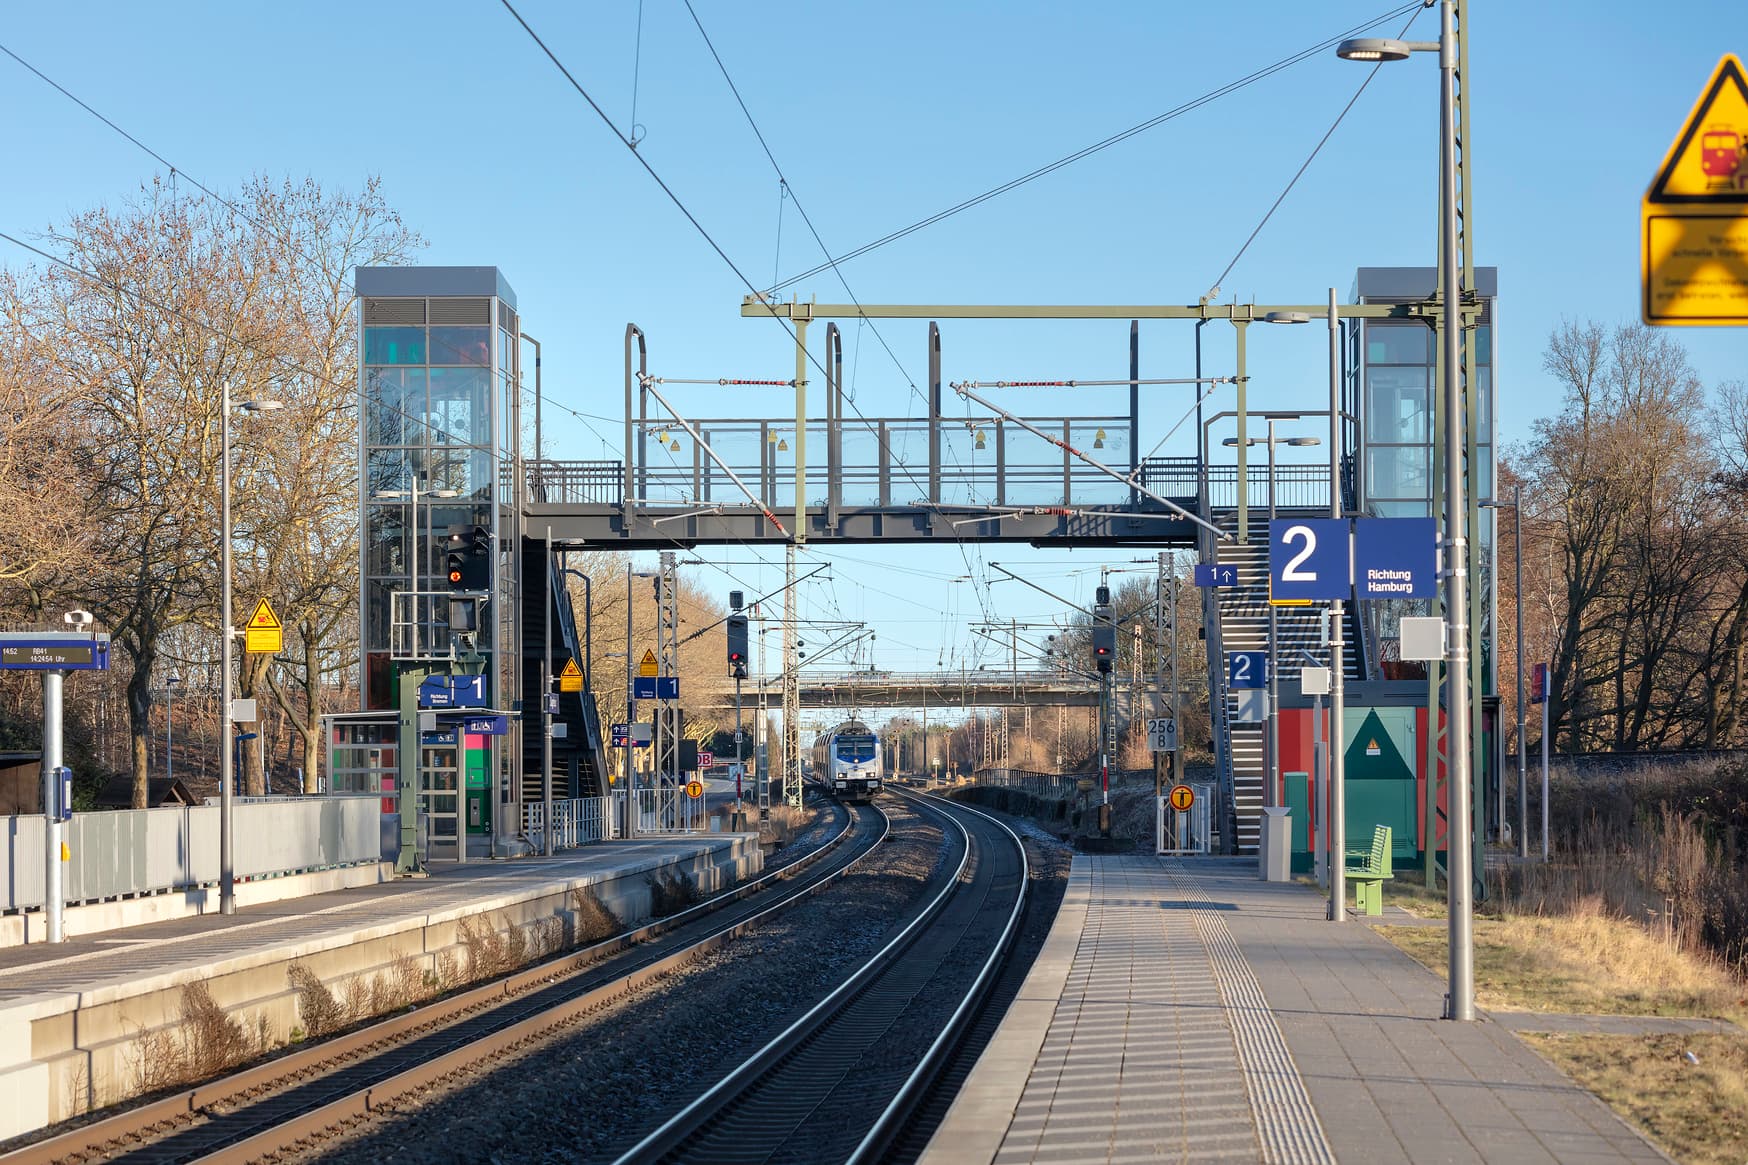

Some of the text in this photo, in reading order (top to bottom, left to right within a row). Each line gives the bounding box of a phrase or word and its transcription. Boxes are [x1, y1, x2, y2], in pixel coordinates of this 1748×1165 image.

[1282, 525, 1317, 582] 2
[1211, 567, 1218, 580] 1
[1368, 569, 1412, 581] Richtung
[1368, 582, 1413, 594] Hamburg
[1234, 654, 1251, 680] 2
[472, 676, 482, 699] 1
[669, 679, 677, 694] 1
[1148, 720, 1175, 734] 256
[1158, 735, 1166, 748] 8
